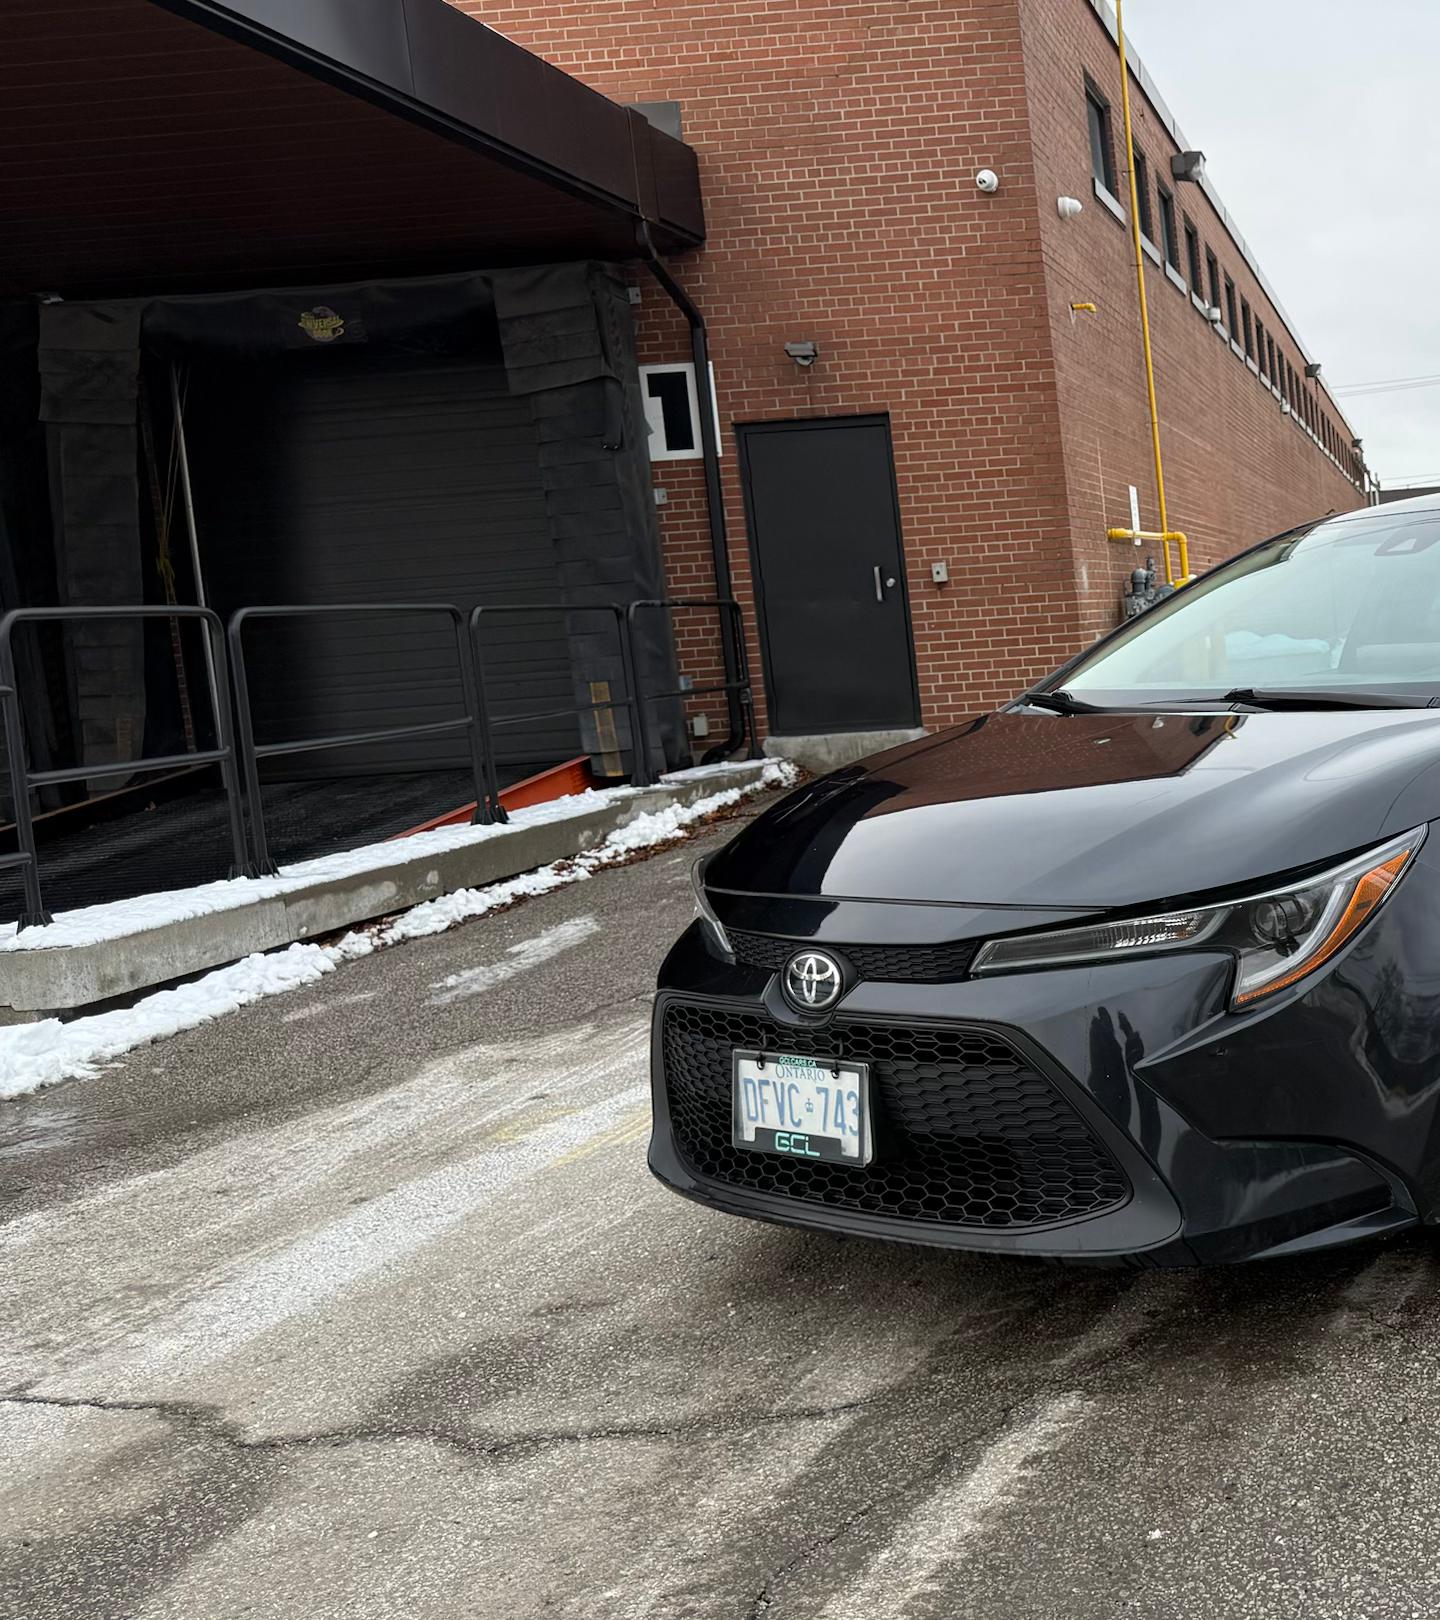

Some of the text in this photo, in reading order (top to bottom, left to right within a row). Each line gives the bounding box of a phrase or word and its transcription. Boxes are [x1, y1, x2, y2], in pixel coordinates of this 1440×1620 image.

[647, 372, 694, 450] 1
[776, 1064, 825, 1081] ONTARIO
[743, 1078, 858, 1136] DFVC 743
